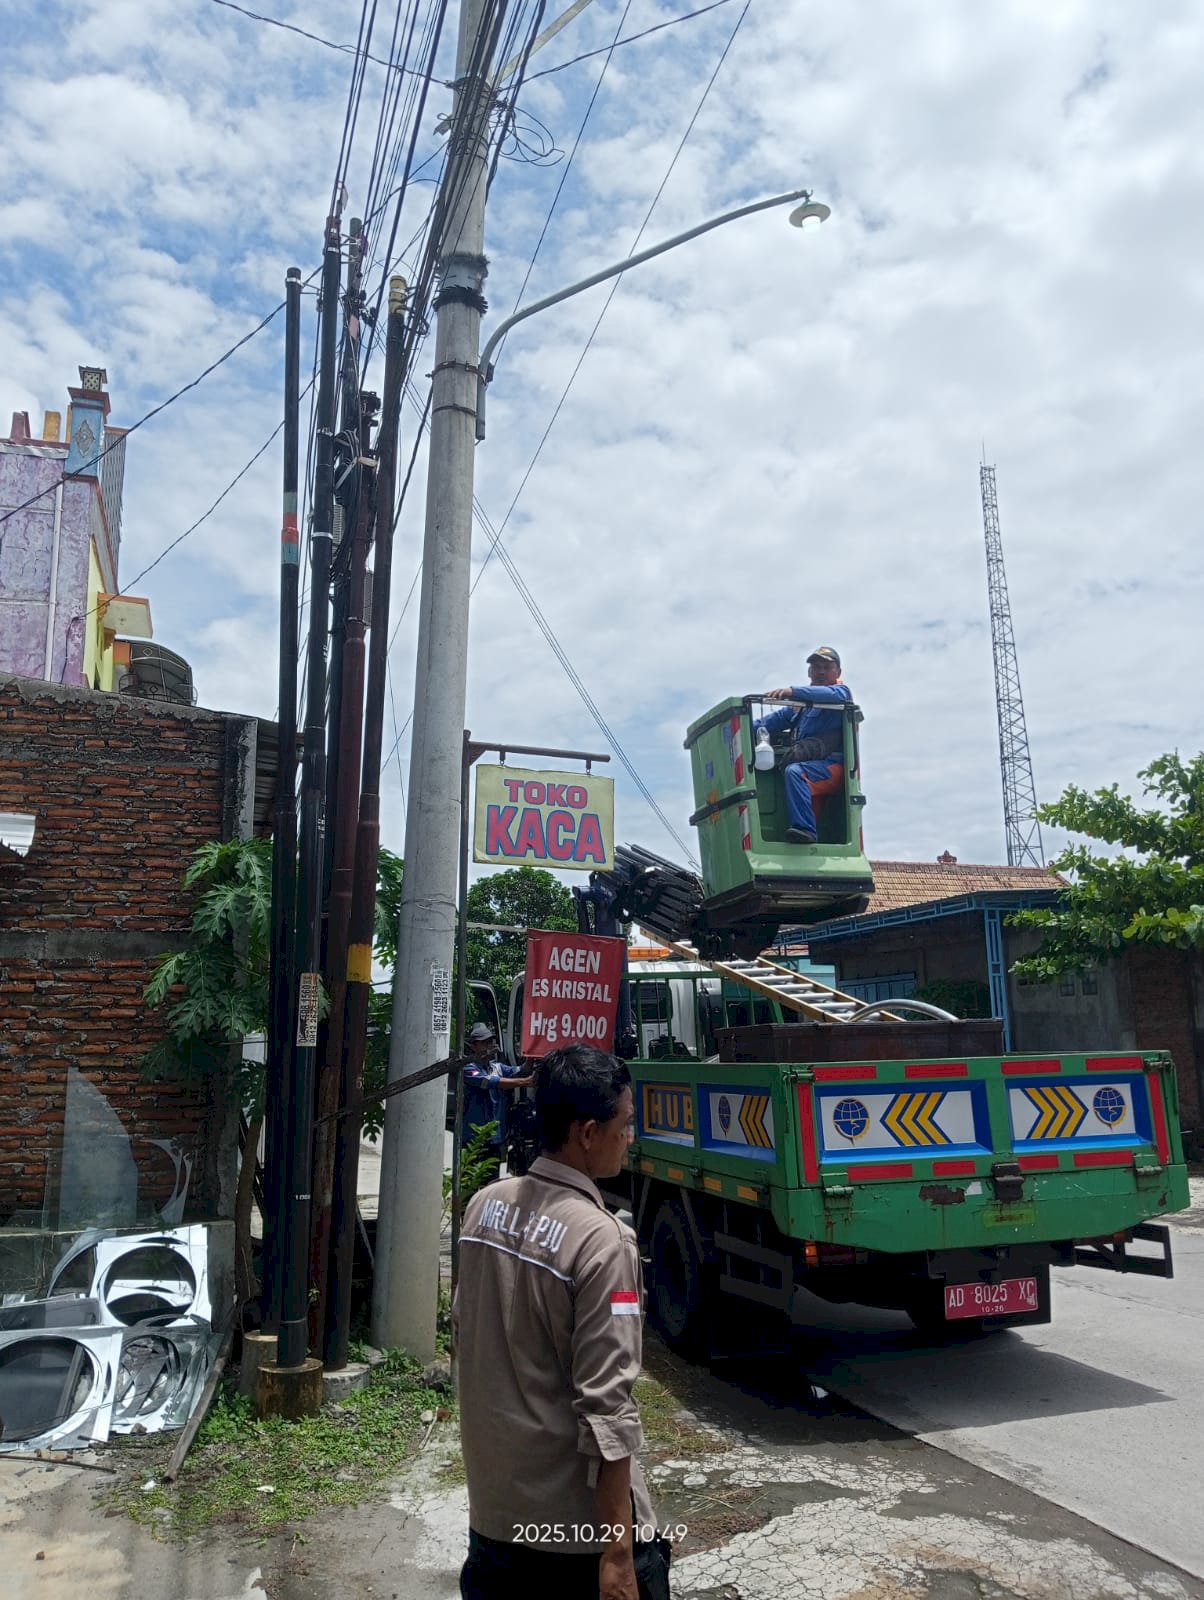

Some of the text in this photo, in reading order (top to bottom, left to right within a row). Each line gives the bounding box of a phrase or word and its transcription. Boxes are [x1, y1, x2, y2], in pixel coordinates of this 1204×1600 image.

[504, 779, 588, 809] TOKO
[486, 805, 606, 864] KACA
[548, 947, 601, 974] AGEN
[531, 979, 612, 1003] ES KRISTAL
[530, 1012, 608, 1042] Hrg 9.000
[650, 1092, 694, 1130] HUB
[529, 1215, 568, 1253] PJU
[949, 1280, 1035, 1308] AD 8025 XC
